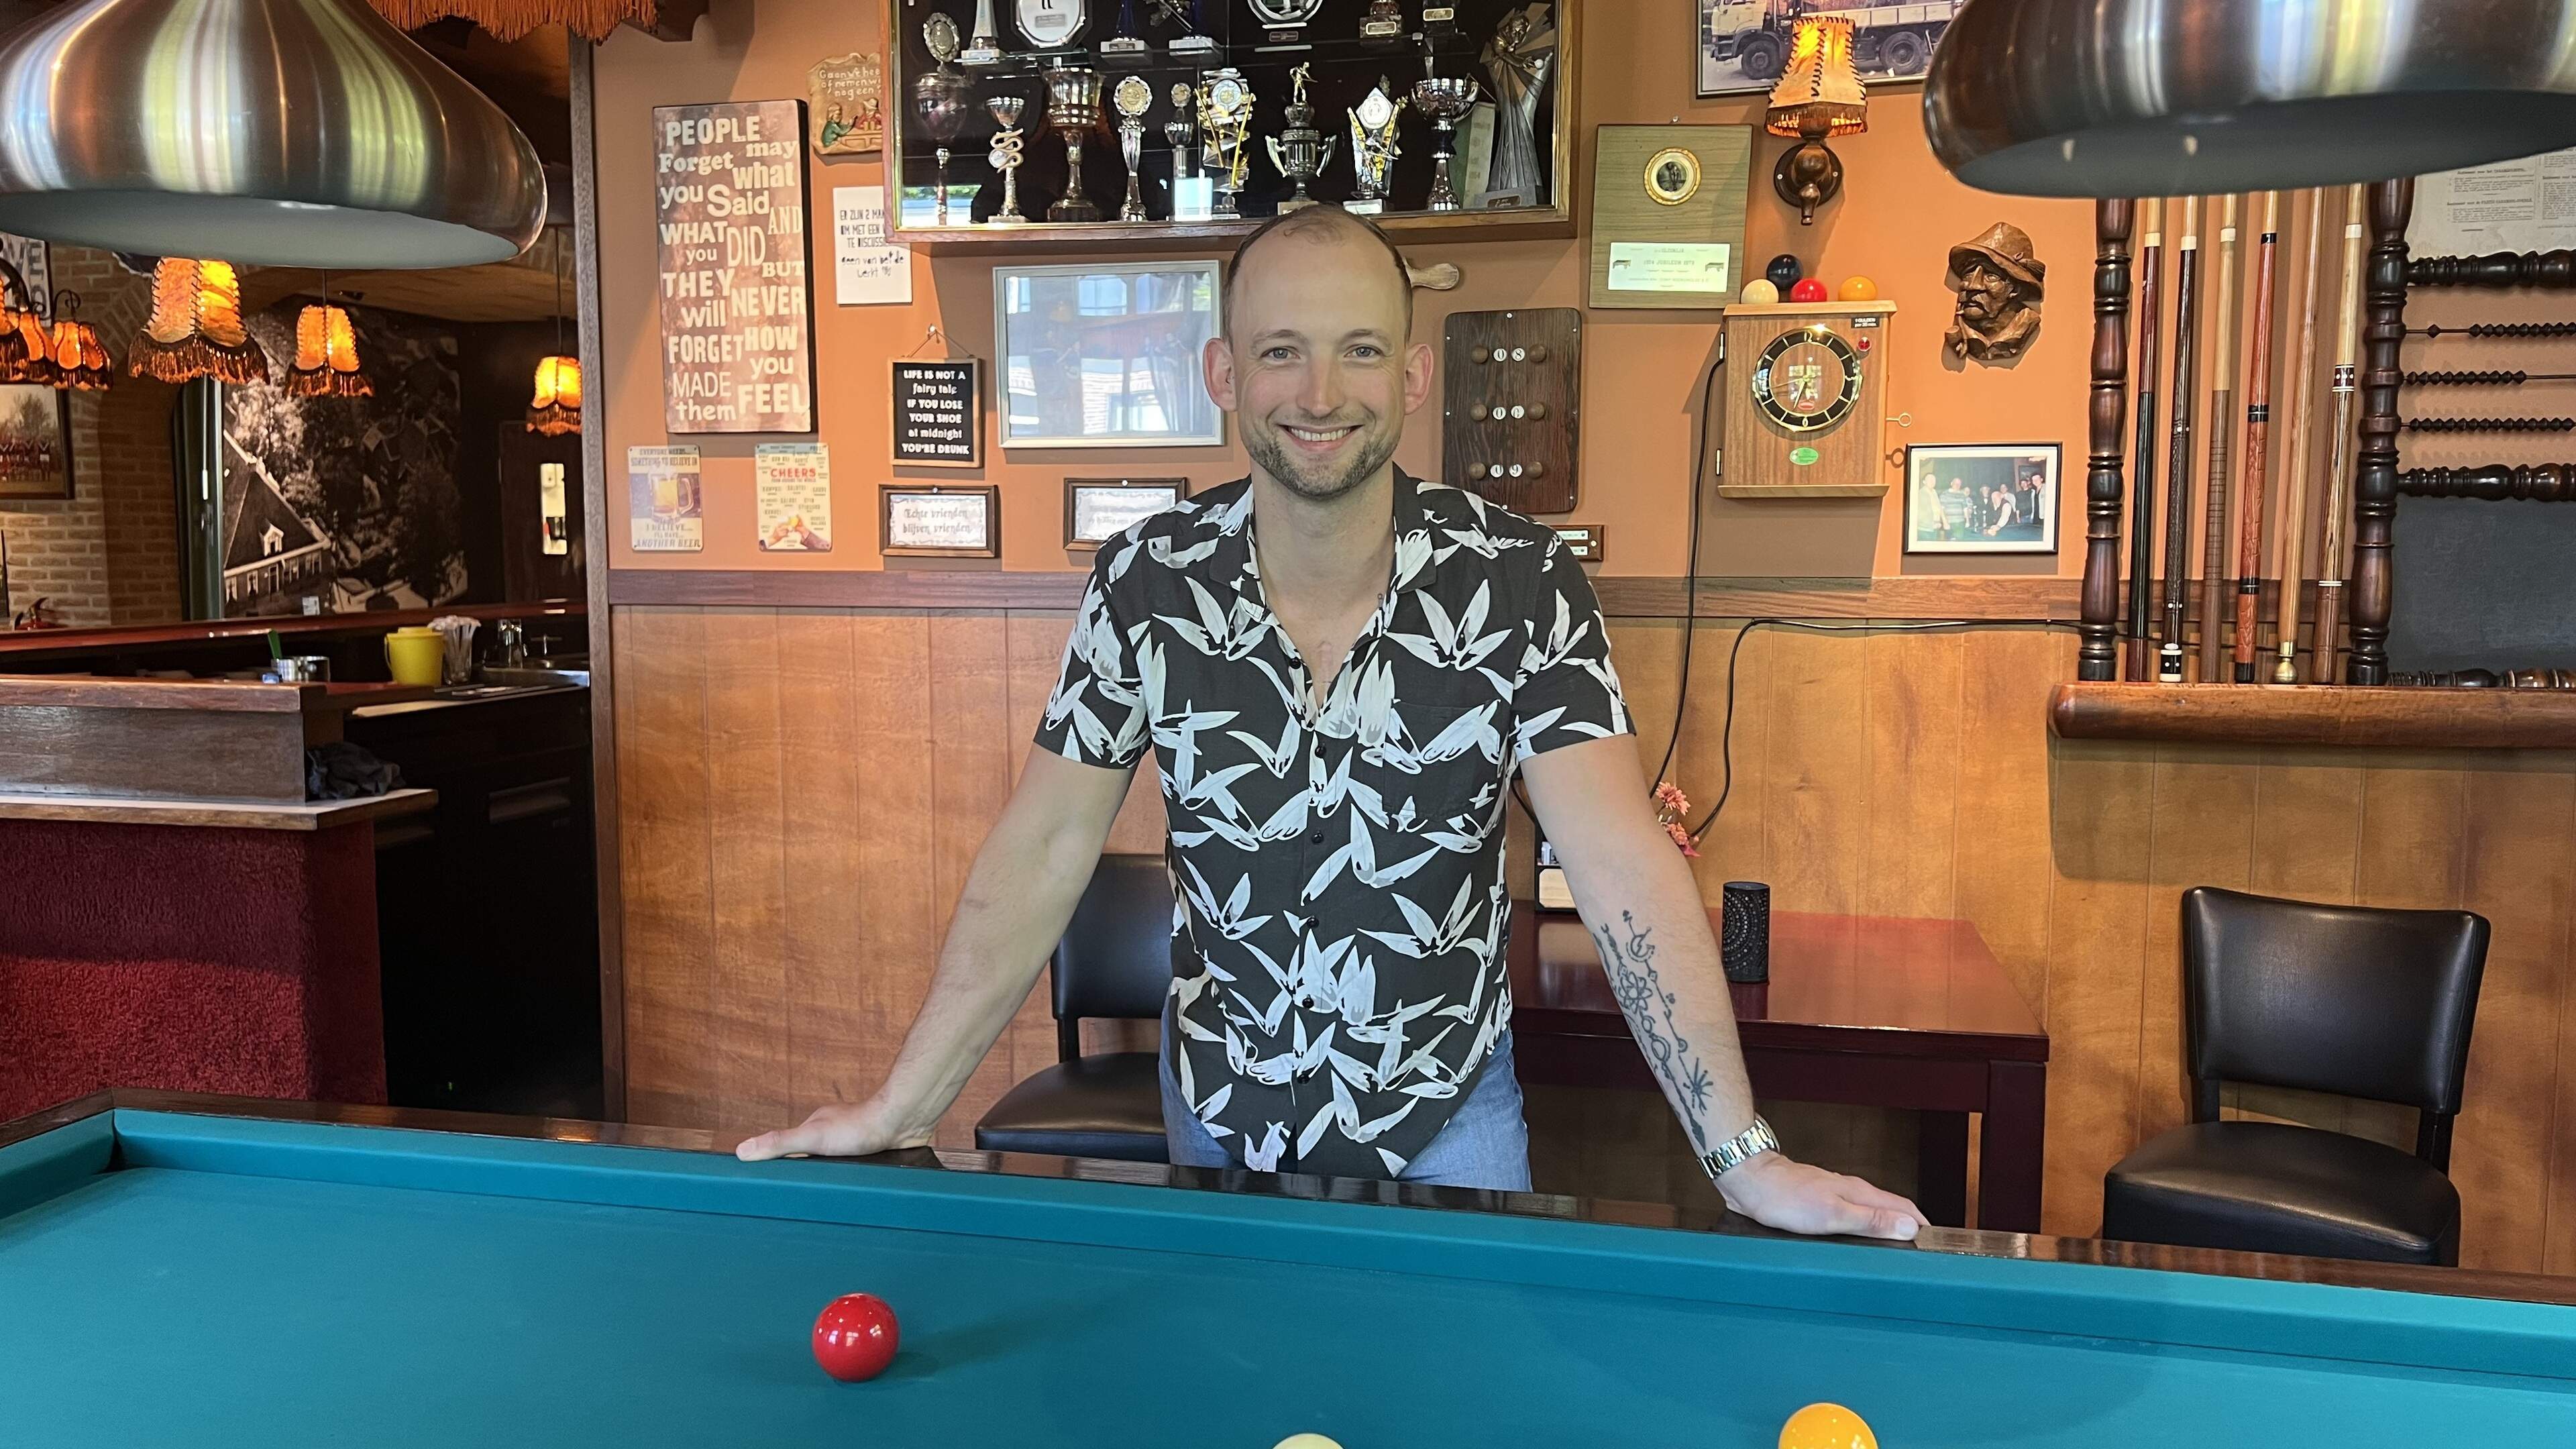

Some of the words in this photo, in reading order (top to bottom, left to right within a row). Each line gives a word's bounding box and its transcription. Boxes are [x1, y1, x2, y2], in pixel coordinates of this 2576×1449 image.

[819, 69, 846, 78] Gaan
[835, 78, 867, 87] nemen
[835, 89, 854, 101] nog
[857, 87, 874, 95] een
[665, 115, 761, 146] PEOPLE
[745, 140, 798, 159] may
[658, 151, 735, 175] Forget
[732, 161, 796, 190] what
[659, 184, 704, 209] you
[706, 183, 770, 217] Said
[659, 221, 728, 246] WHAT
[767, 205, 804, 235] AND
[686, 248, 718, 266] you
[726, 225, 766, 267] DID
[662, 268, 735, 299] THEY
[761, 260, 804, 278] BUT
[680, 299, 727, 327] will
[731, 285, 806, 317] NEVER
[667, 334, 745, 364] FORGET
[744, 325, 798, 352] HOW
[672, 371, 732, 398] MADE
[749, 356, 794, 380] you
[903, 370, 923, 380] LIFE
[924, 370, 934, 380] IS
[935, 370, 955, 380] NOT
[958, 371, 966, 380] A
[912, 382, 936, 396] fairy
[938, 384, 957, 394] tale
[676, 398, 737, 421] them
[738, 382, 809, 415] FEEL
[906, 398, 916, 408] IF
[918, 399, 938, 409] YOU
[940, 400, 963, 410] LOSE
[908, 413, 934, 423] YOUR
[936, 413, 962, 423] SHOE
[908, 428, 918, 437] at
[920, 428, 962, 441] midnight
[902, 443, 936, 453] YOU'RE
[937, 444, 969, 455] DRUNK
[771, 468, 816, 478] CHEERS
[904, 508, 928, 521] Echte
[931, 506, 969, 520] vrienden
[903, 523, 931, 535] blijven
